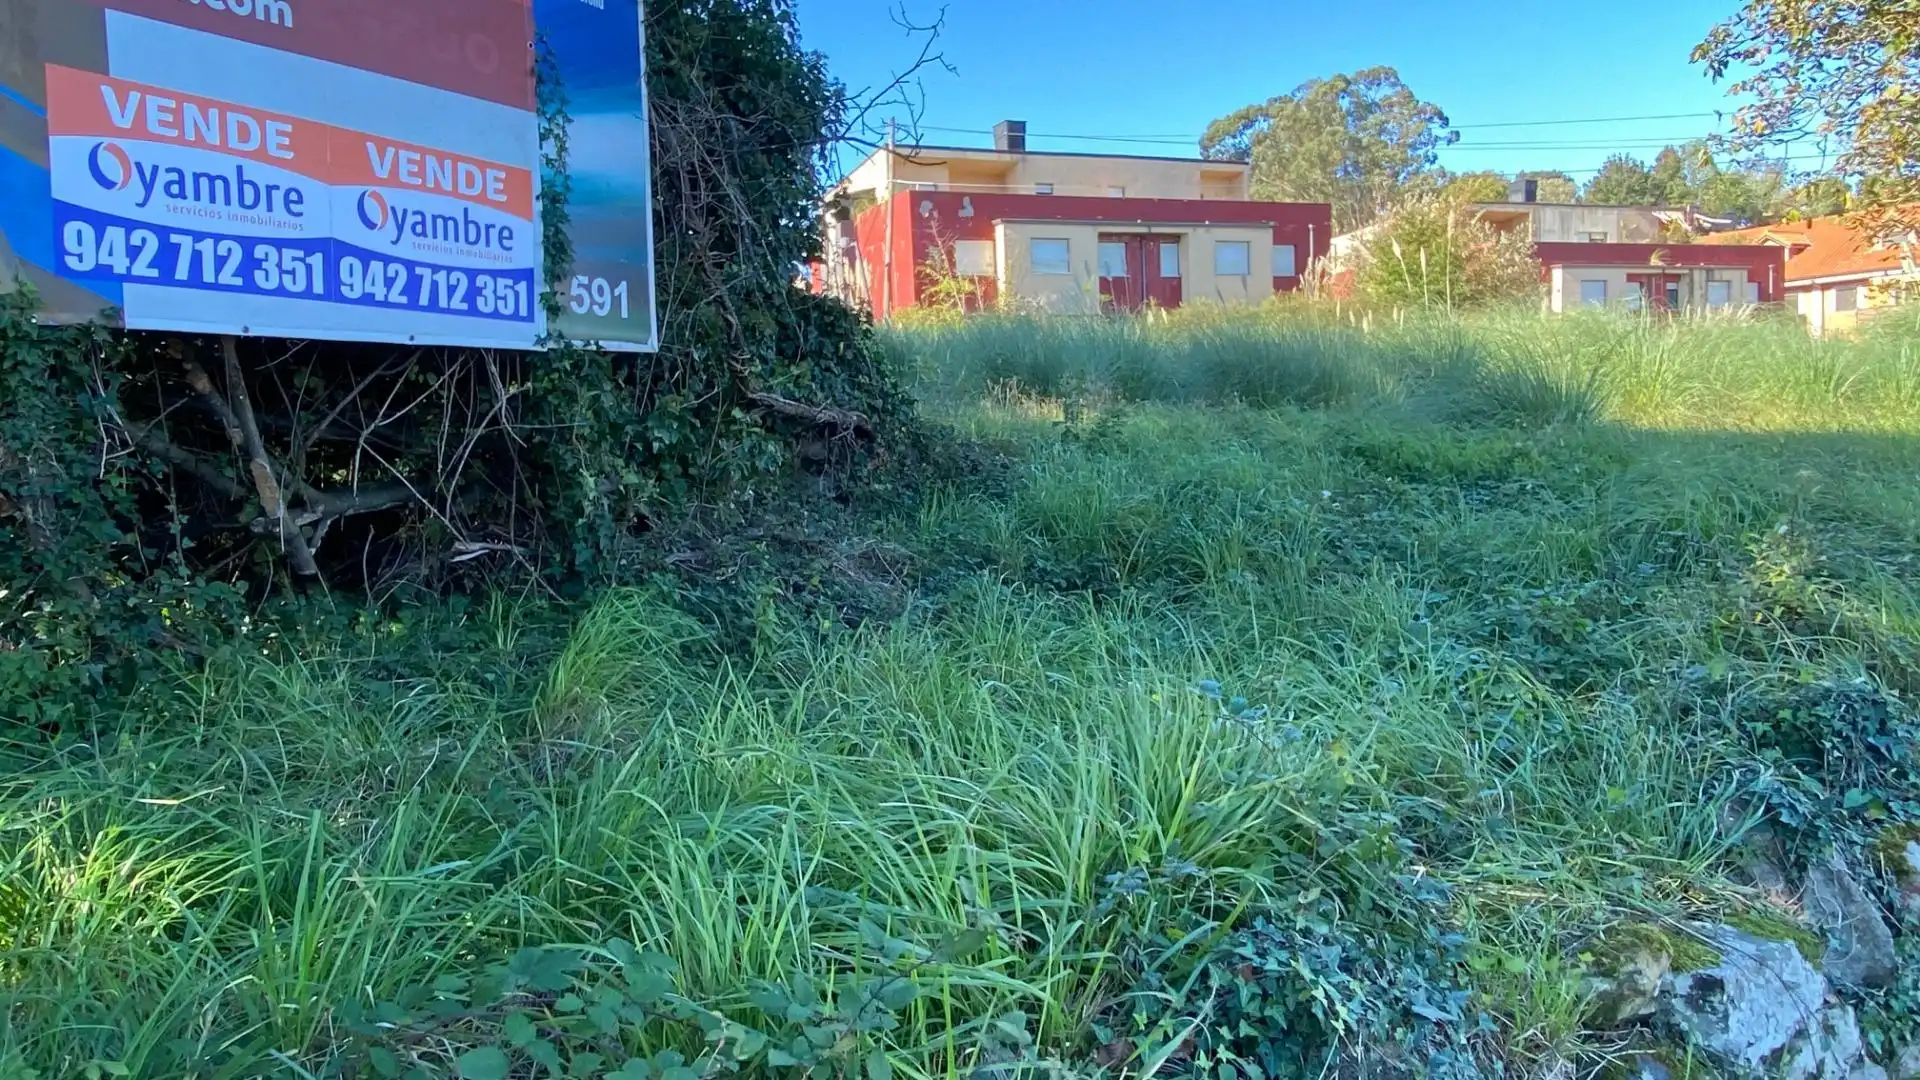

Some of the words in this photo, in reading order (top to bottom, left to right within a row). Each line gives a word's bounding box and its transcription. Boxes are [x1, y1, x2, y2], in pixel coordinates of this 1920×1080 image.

[100, 84, 295, 159] VENDE
[88, 141, 304, 217] Oyambre
[365, 141, 508, 202] VENDE
[165, 204, 222, 220] servicios
[227, 211, 304, 231] inmobiliarios
[357, 188, 514, 251] Oyambre
[412, 241, 453, 255] servicios
[63, 220, 159, 277] 942
[169, 233, 244, 286] 712
[253, 244, 325, 295] 351
[339, 255, 408, 304] 942
[414, 266, 469, 311] 712
[475, 274, 529, 317] 351
[569, 274, 629, 319] 591
